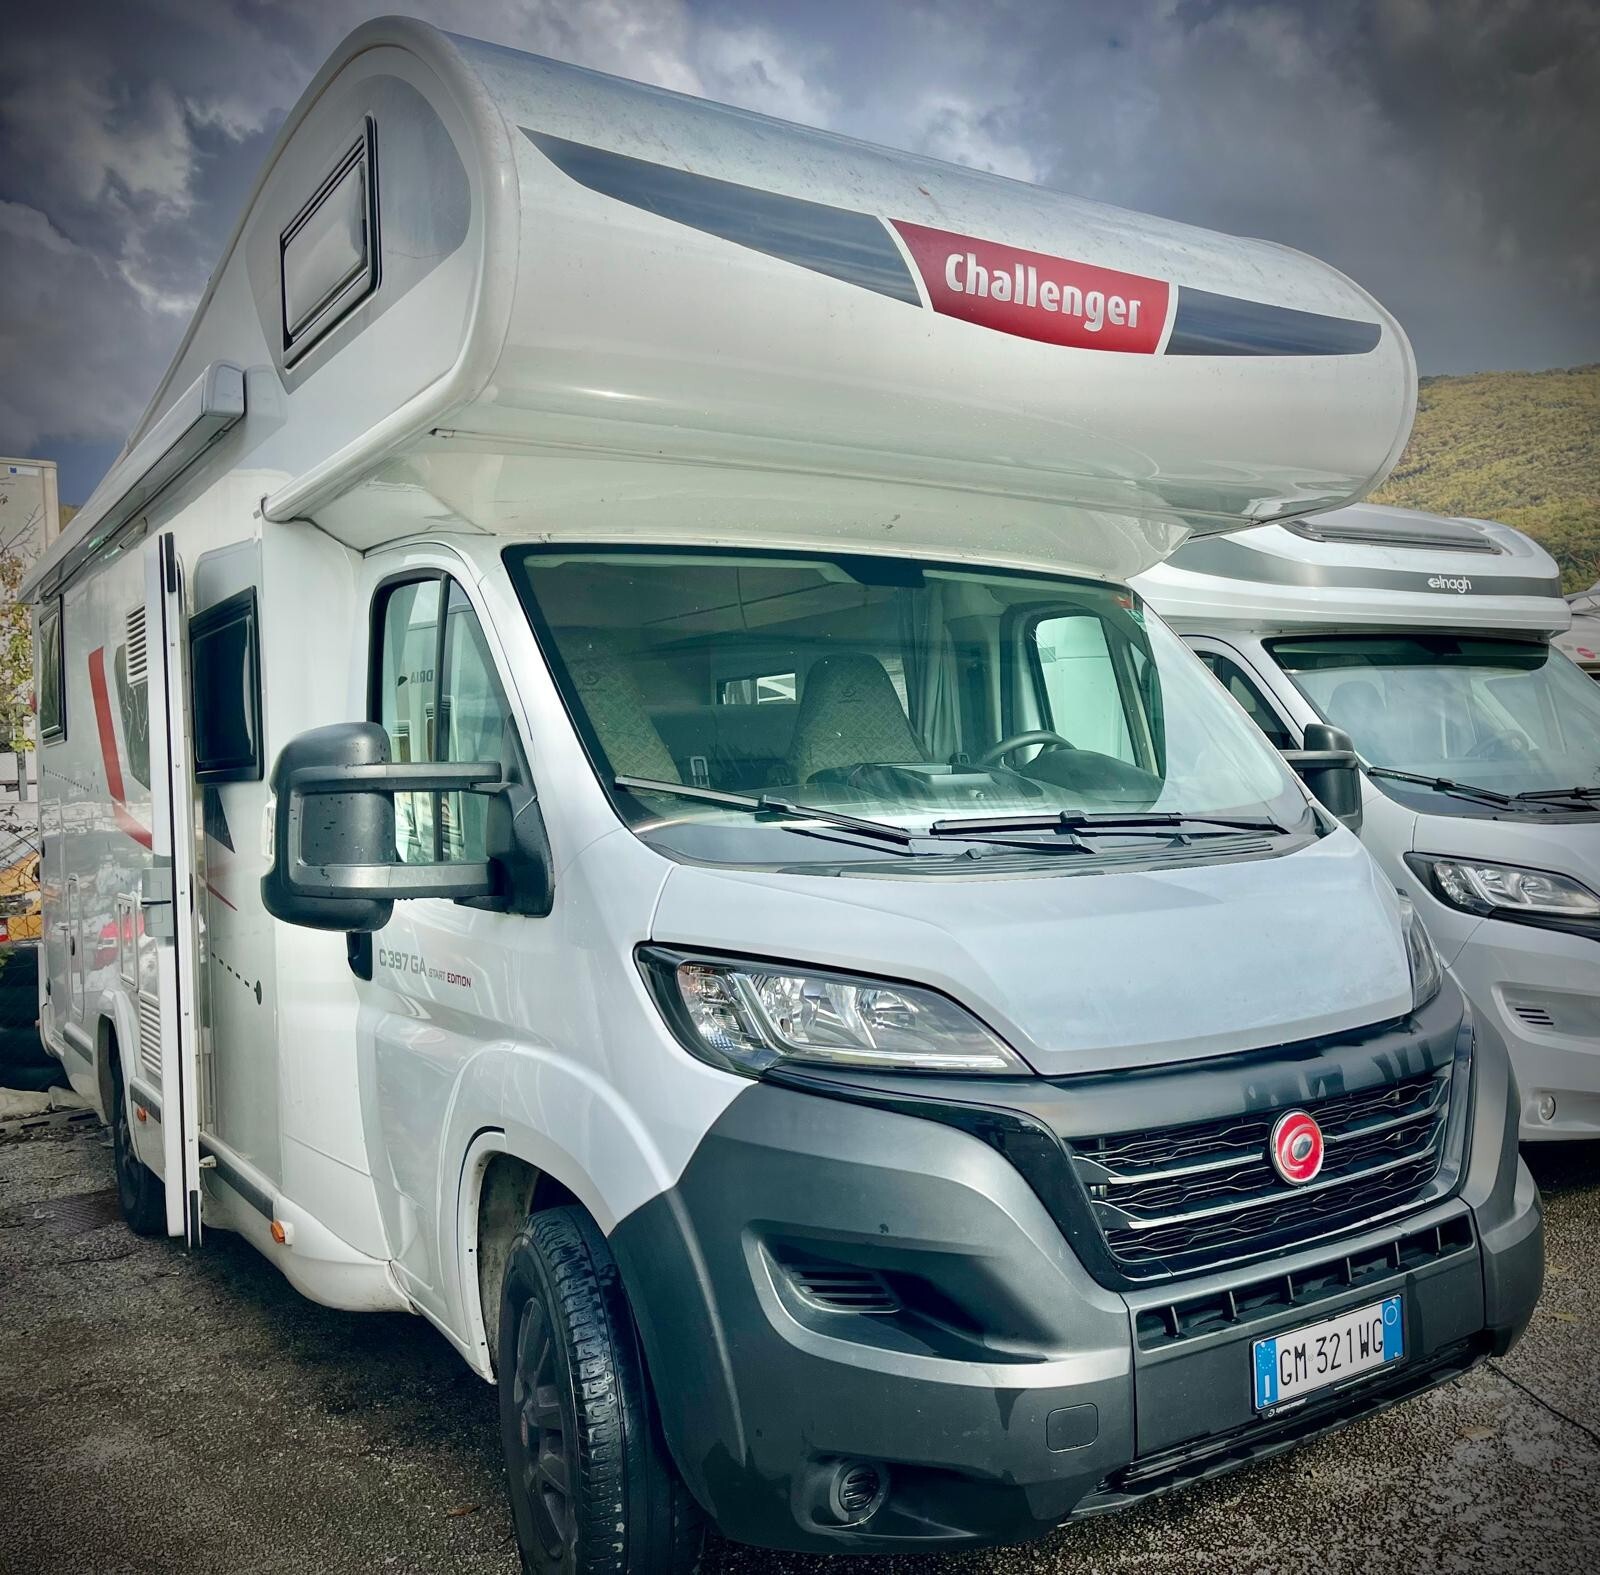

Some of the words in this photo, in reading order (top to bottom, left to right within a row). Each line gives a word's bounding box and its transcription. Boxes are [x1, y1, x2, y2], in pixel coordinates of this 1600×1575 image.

[945, 252, 1141, 332] Challenger
[1428, 575, 1472, 594] elnagh
[428, 968, 446, 979] START
[447, 972, 472, 988] EDITION
